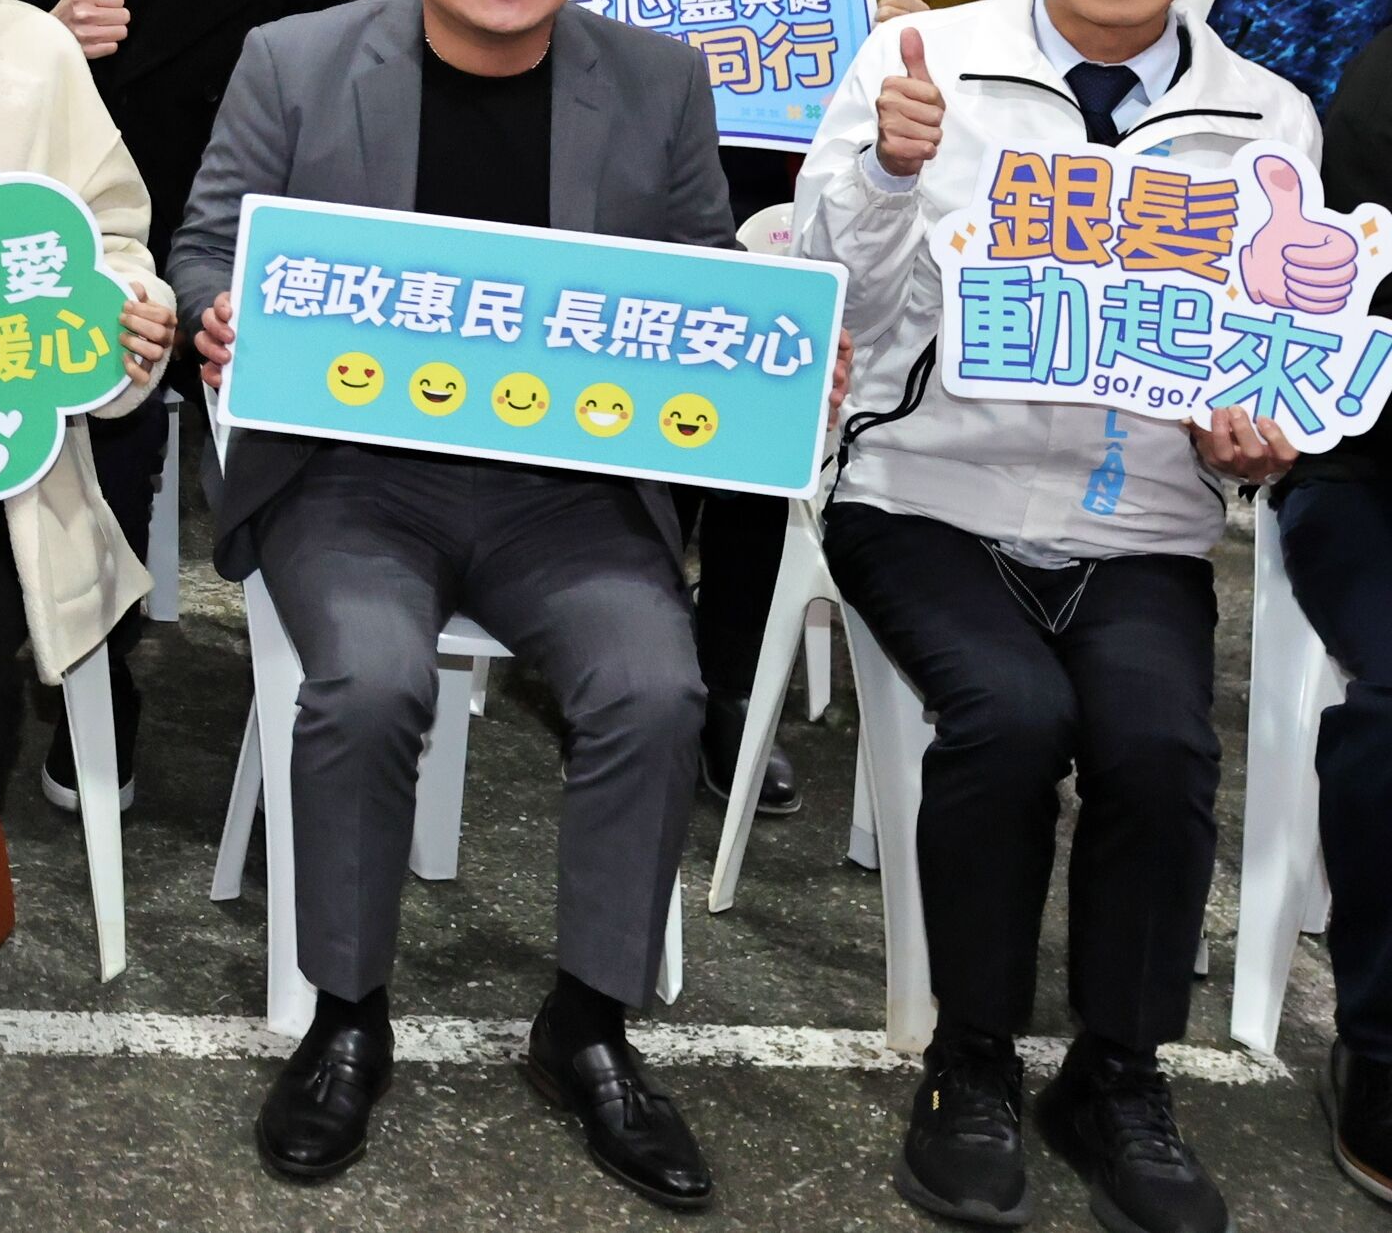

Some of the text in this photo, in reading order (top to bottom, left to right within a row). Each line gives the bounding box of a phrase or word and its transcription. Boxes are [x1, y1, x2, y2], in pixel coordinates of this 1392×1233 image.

[988, 150, 1239, 284] 銀髮
[262, 256, 812, 377] 德政惠民 長照安心
[959, 267, 1392, 435] 動起來!
[1093, 374, 1202, 409] go! go!
